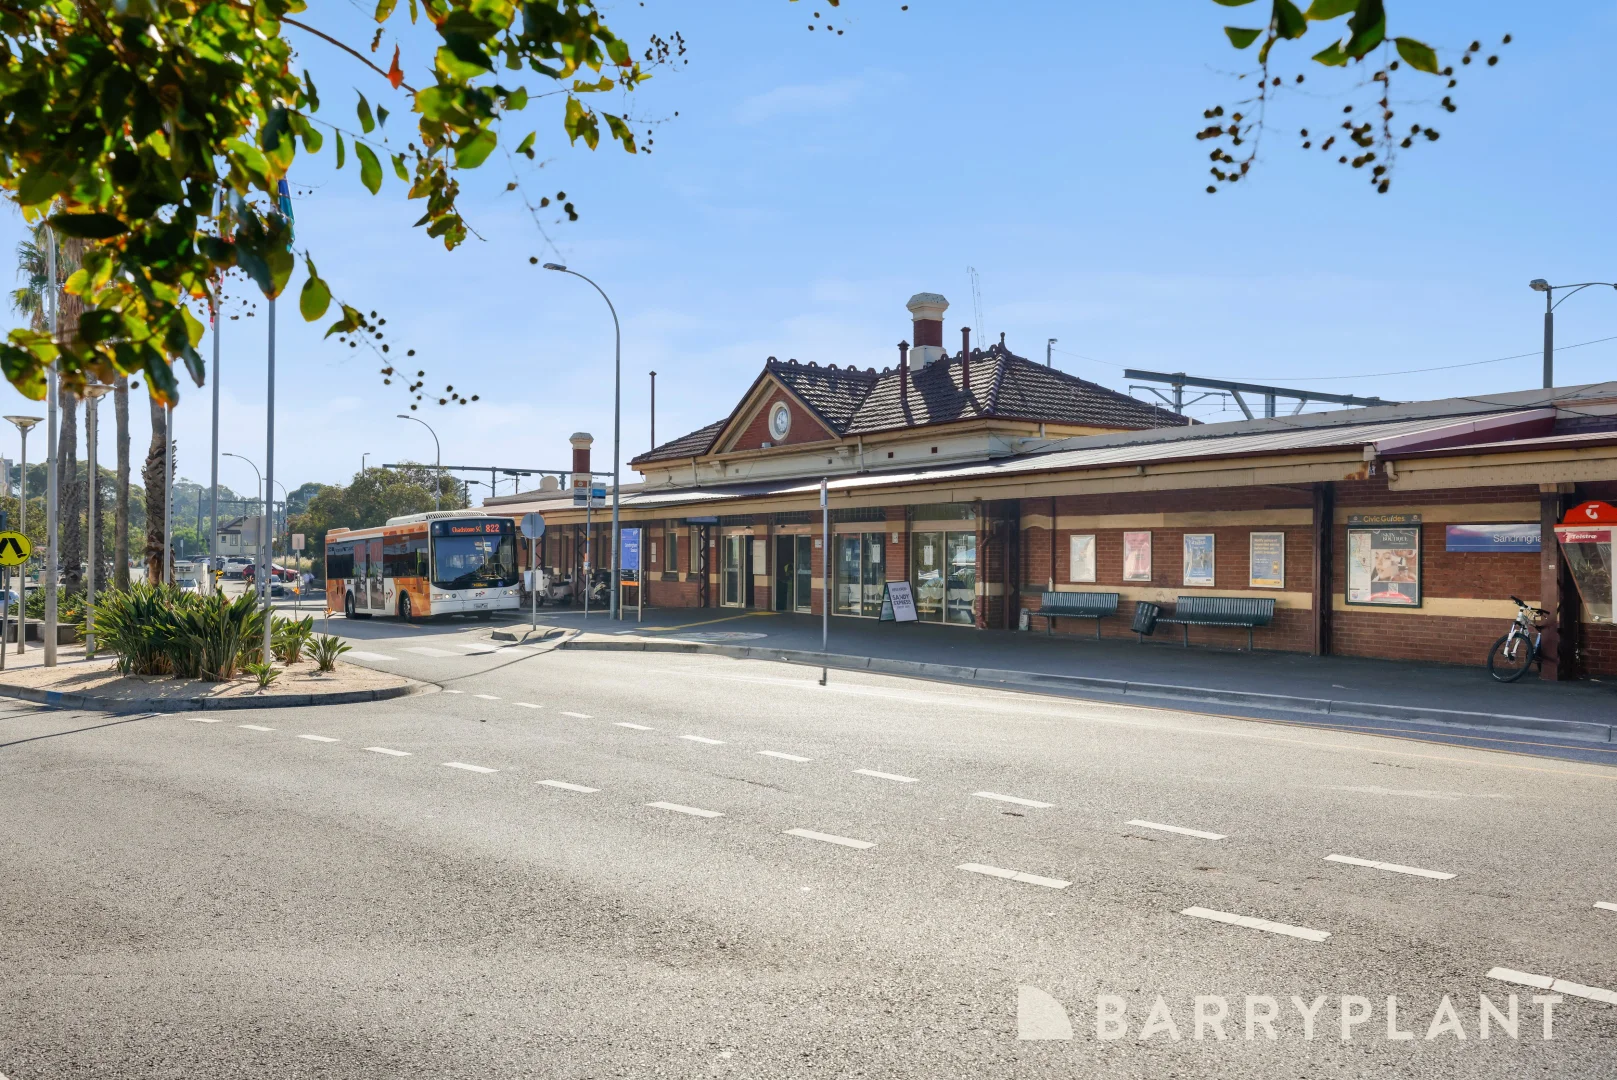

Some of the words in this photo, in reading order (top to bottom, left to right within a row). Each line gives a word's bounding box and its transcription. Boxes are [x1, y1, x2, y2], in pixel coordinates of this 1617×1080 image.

[1363, 515, 1380, 523] Civic
[1380, 515, 1405, 523] Guides
[485, 523, 500, 533] 822
[1493, 533, 1541, 545] Sandringha
